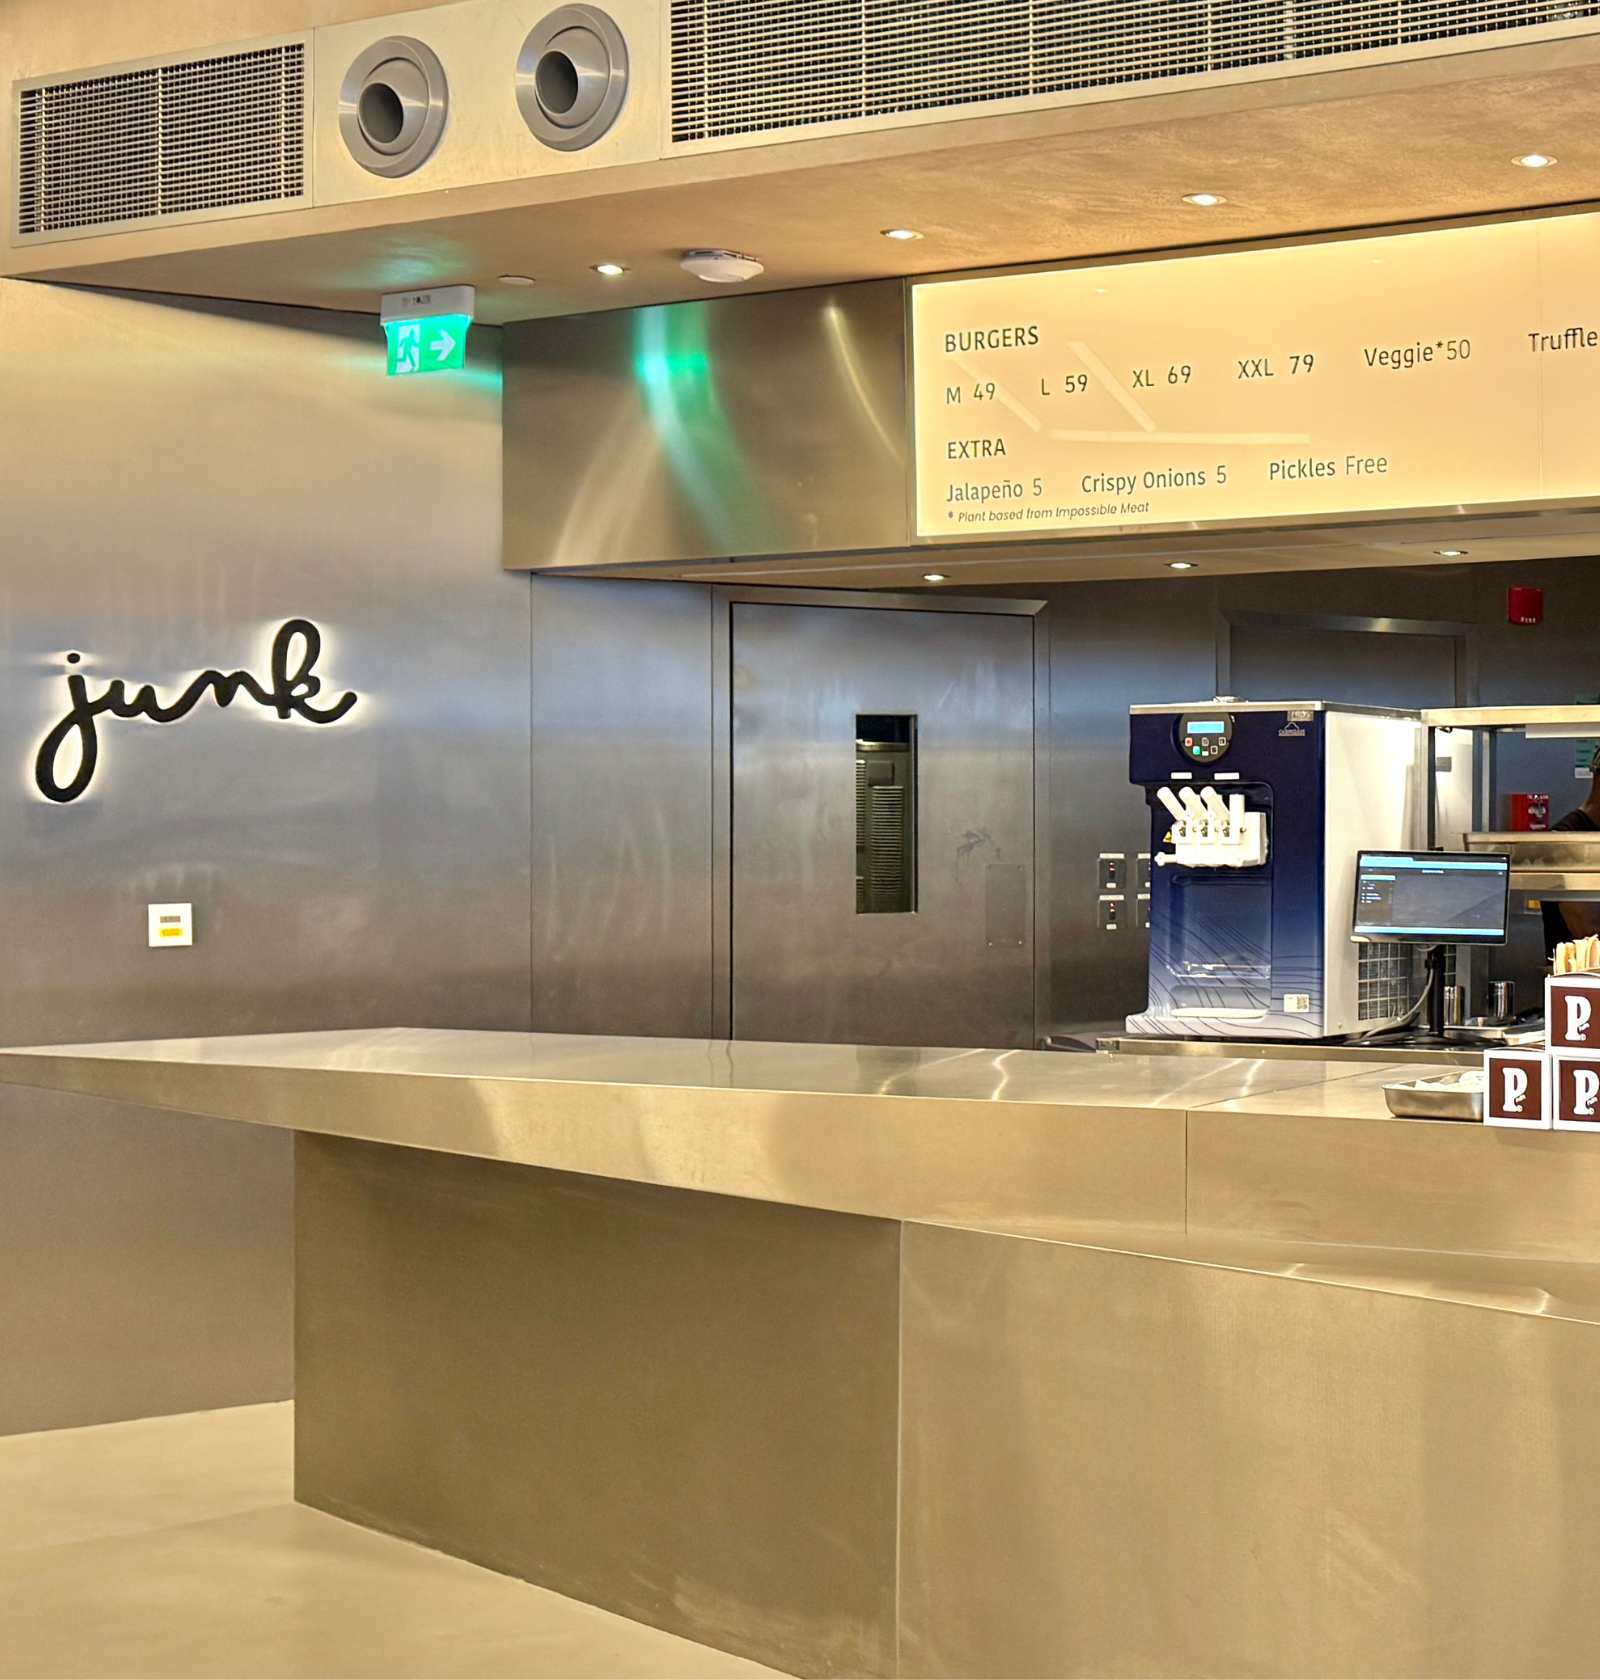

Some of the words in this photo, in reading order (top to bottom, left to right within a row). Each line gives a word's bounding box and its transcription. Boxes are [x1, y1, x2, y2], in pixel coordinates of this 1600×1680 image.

[946, 326, 1038, 352] BURGERS
[947, 387, 960, 404] M
[974, 383, 995, 400] 49
[1042, 378, 1050, 395] L
[1066, 374, 1087, 393] 59
[1133, 369, 1154, 388] XL
[1168, 366, 1191, 384] 69
[1238, 359, 1274, 379] XXL
[1290, 354, 1313, 374] 79
[1528, 328, 1598, 352] Truffle
[948, 439, 1006, 459] EXTRA
[947, 480, 1022, 504] Jalapeño
[1033, 478, 1042, 496] 5
[1082, 473, 1136, 495] Crispy
[1144, 468, 1205, 488] Onions
[1217, 465, 1226, 484] 5
[1270, 458, 1335, 480] Pickles
[1346, 456, 1387, 475] Free
[958, 511, 986, 523] Plant
[988, 508, 1024, 521] based
[1026, 507, 1053, 519] from
[1055, 503, 1118, 521] Impossible
[1120, 501, 1150, 515] Meat
[35, 619, 357, 803] junk
